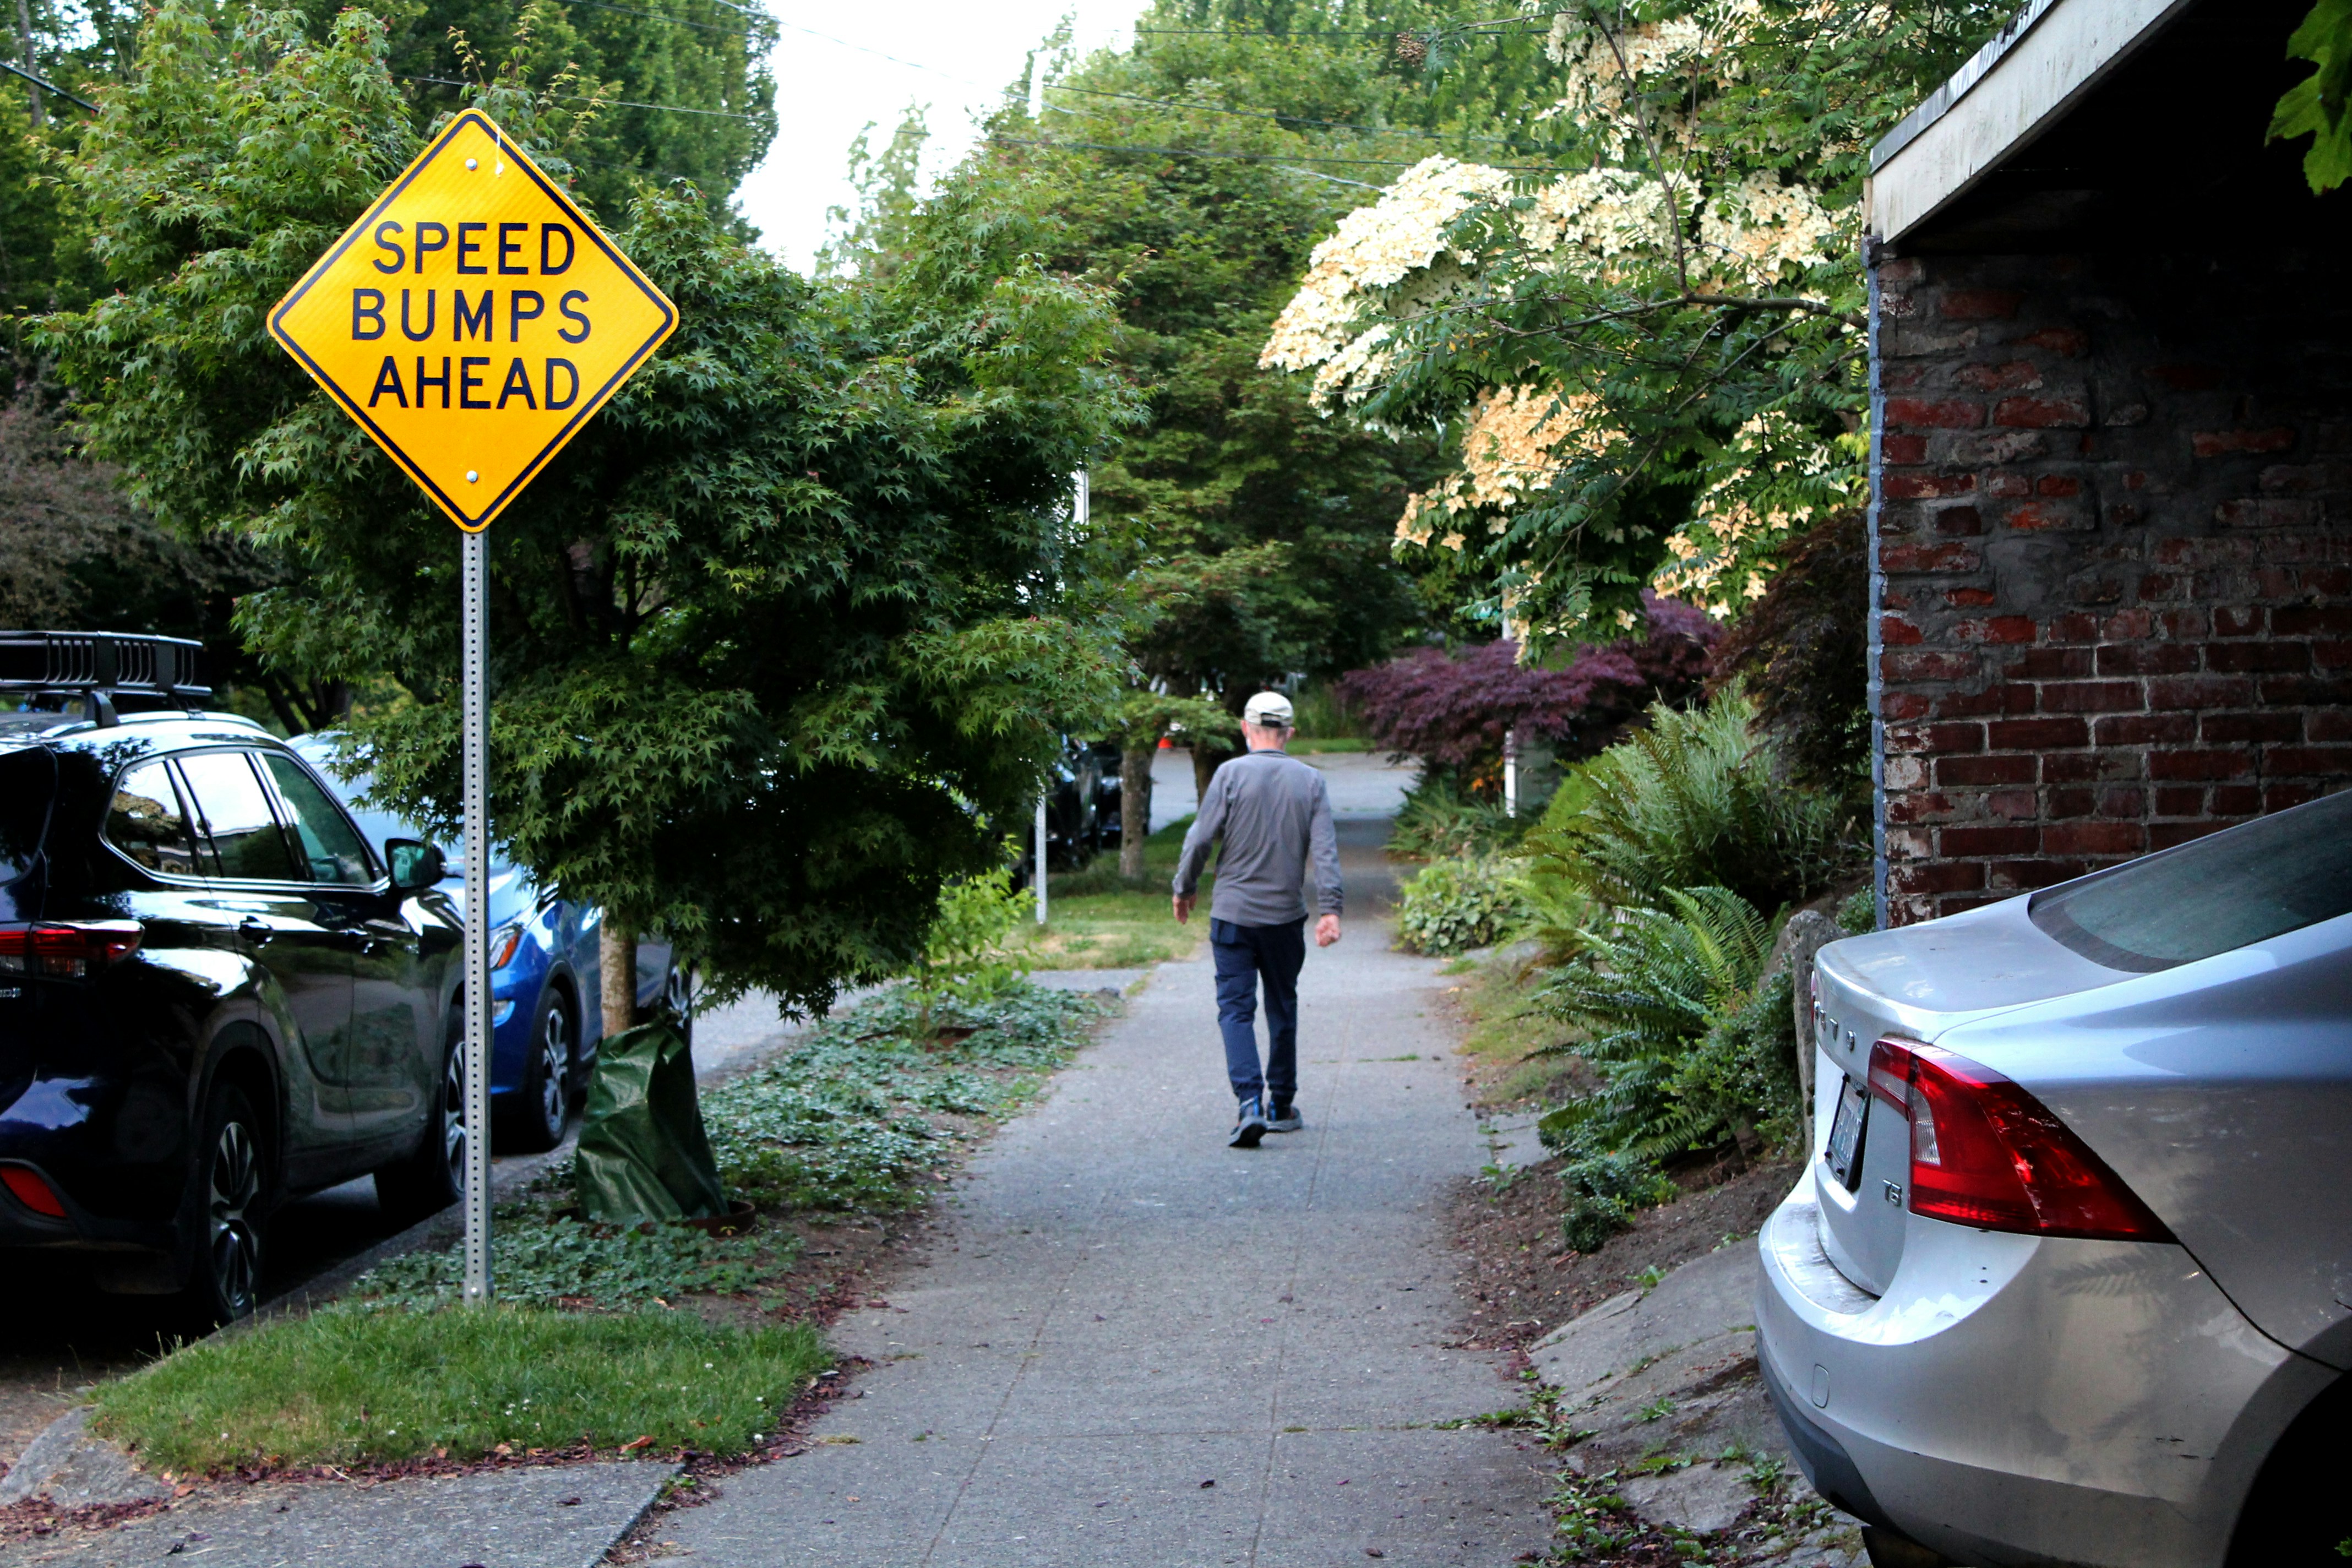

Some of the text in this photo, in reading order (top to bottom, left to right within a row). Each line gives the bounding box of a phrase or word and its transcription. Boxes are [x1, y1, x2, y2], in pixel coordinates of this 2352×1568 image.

[372, 221, 575, 275] SPEED
[351, 288, 591, 344] BUMPS
[368, 356, 580, 411] AHEAD
